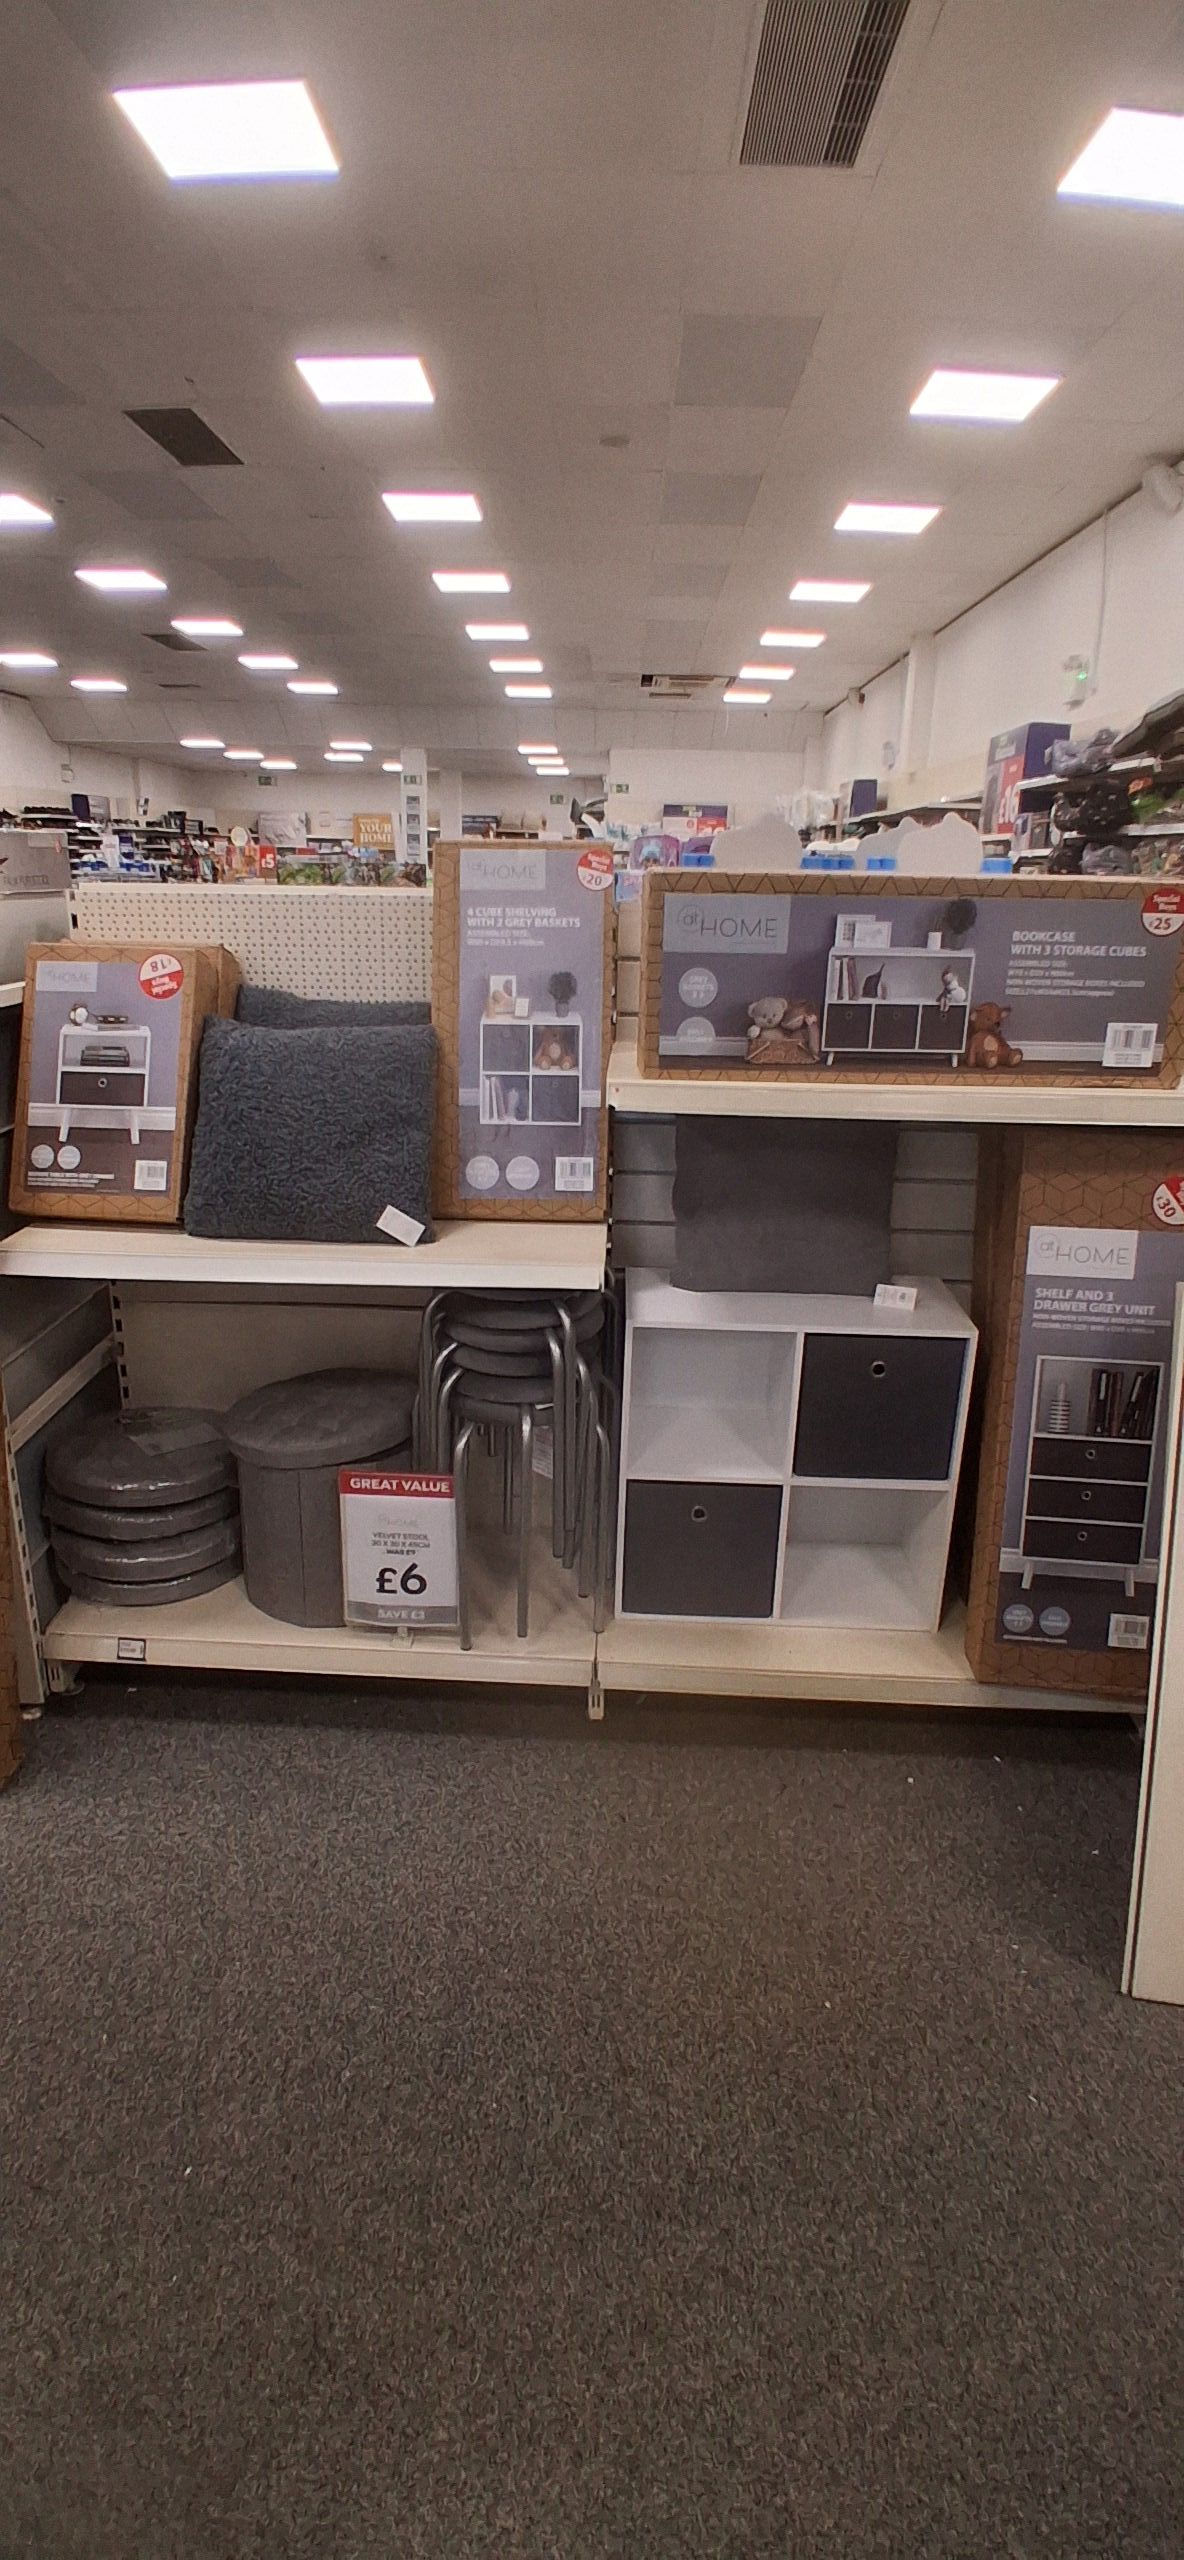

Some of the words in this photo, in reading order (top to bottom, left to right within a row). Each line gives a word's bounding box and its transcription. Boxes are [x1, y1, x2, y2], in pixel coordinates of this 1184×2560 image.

[359, 822, 393, 834] YOUR
[261, 853, 275, 869] £5
[483, 864, 540, 880] HOME
[467, 908, 474, 917] 4
[475, 908, 502, 918] CUBE
[505, 908, 557, 918] SHELVING
[467, 918, 496, 928] WITH
[504, 918, 532, 928] GREY
[534, 918, 581, 928] BASKETS
[700, 917, 778, 938] HOME
[1012, 930, 1077, 943] BOOKCASE
[1010, 943, 1042, 956] WITH
[1043, 945, 1051, 956] 3
[1054, 945, 1106, 957] STORAGE
[1108, 946, 1148, 958] CUBES
[1055, 1245, 1131, 1266] HOME
[1035, 1287, 1074, 1300] SHELF
[1076, 1289, 1104, 1301] AND
[1105, 1291, 1114, 1301] 3
[1033, 1300, 1088, 1312] DRAWER
[1089, 1302, 1122, 1314] GREY
[1125, 1304, 1157, 1316] UNIT
[349, 1477, 400, 1491] GREAT
[401, 1479, 451, 1493] VALUE
[375, 1562, 428, 1595] £6
[377, 1608, 408, 1619] SAVE
